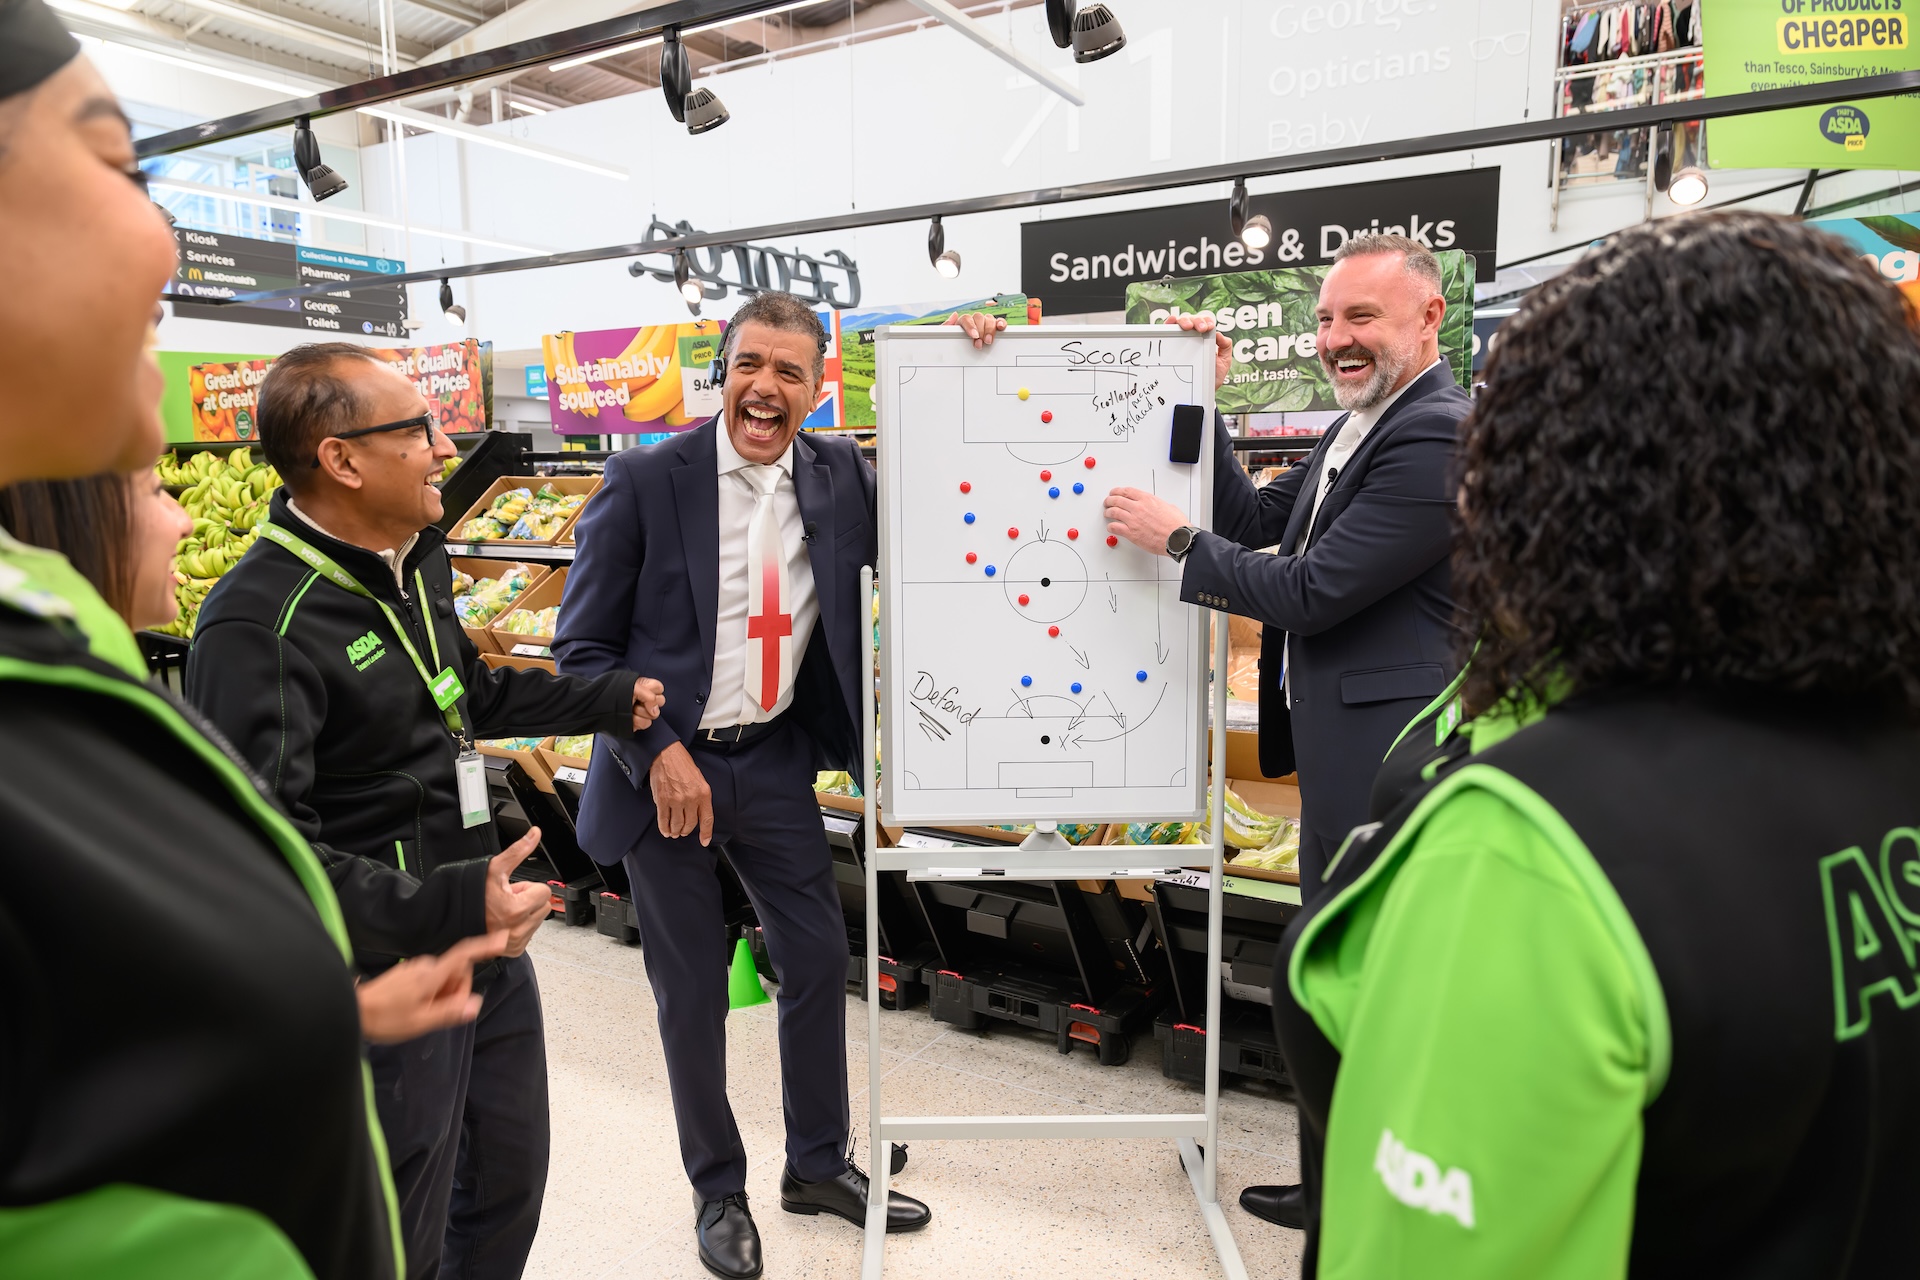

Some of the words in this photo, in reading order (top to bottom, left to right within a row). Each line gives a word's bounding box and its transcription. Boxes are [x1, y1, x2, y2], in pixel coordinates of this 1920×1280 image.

[1268, 45, 1451, 98] Opticians
[1744, 61, 1771, 73] than
[1773, 61, 1808, 76] Tesco,
[1268, 112, 1372, 152] Baby
[1827, 116, 1863, 134] ASDA
[185, 232, 219, 247] Kiosk
[1050, 236, 1265, 283] Sandwiches
[1277, 228, 1305, 262] &
[1320, 214, 1456, 258] Dks
[186, 250, 236, 267] Services
[204, 270, 257, 286] McDonald's
[301, 266, 351, 282] Pharmacy
[306, 316, 340, 330] Toilets
[692, 340, 711, 349] ASDA
[1233, 332, 1318, 364] care
[417, 348, 464, 374] Quality
[555, 352, 671, 386] Sustainably
[204, 369, 241, 391] Great
[430, 372, 471, 395] Prices
[1233, 371, 1260, 384] and
[1263, 368, 1298, 382] taste
[203, 393, 217, 411] at
[218, 389, 254, 409] Great
[559, 382, 631, 411] sourced
[346, 630, 383, 665] ASDA
[909, 671, 981, 726] Defend
